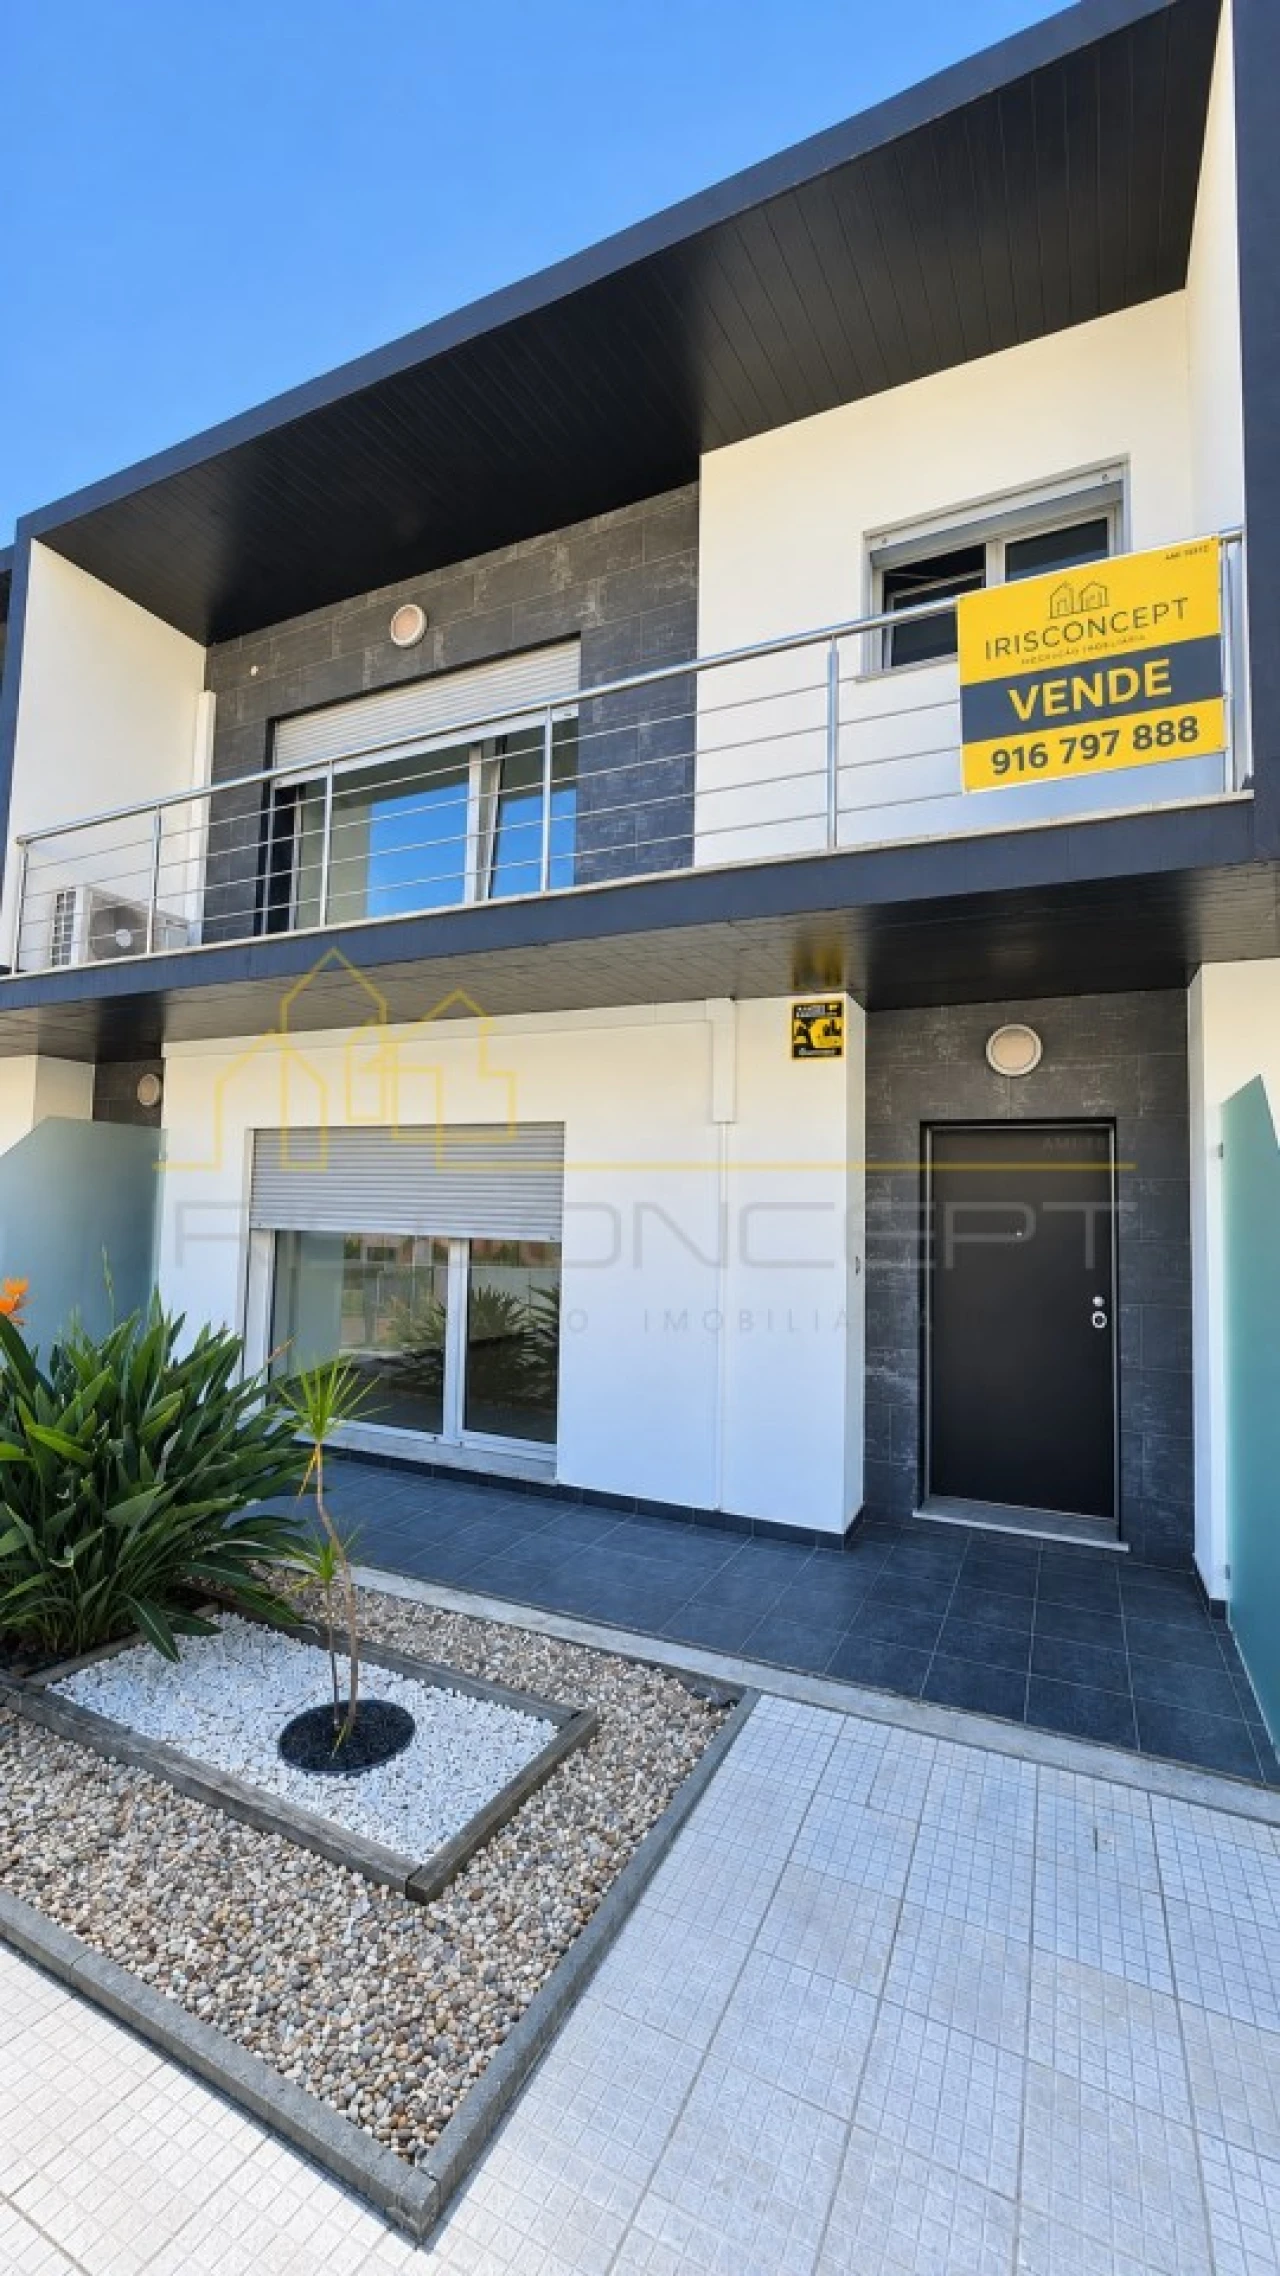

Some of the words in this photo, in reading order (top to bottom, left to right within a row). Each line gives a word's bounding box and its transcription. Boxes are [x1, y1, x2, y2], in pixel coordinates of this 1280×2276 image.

[985, 597, 1188, 660] IRISCONCEPT
[1007, 658, 1172, 722] VENDE
[991, 742, 1049, 775] 916
[1059, 729, 1121, 764] 797
[1132, 715, 1199, 750] 888
